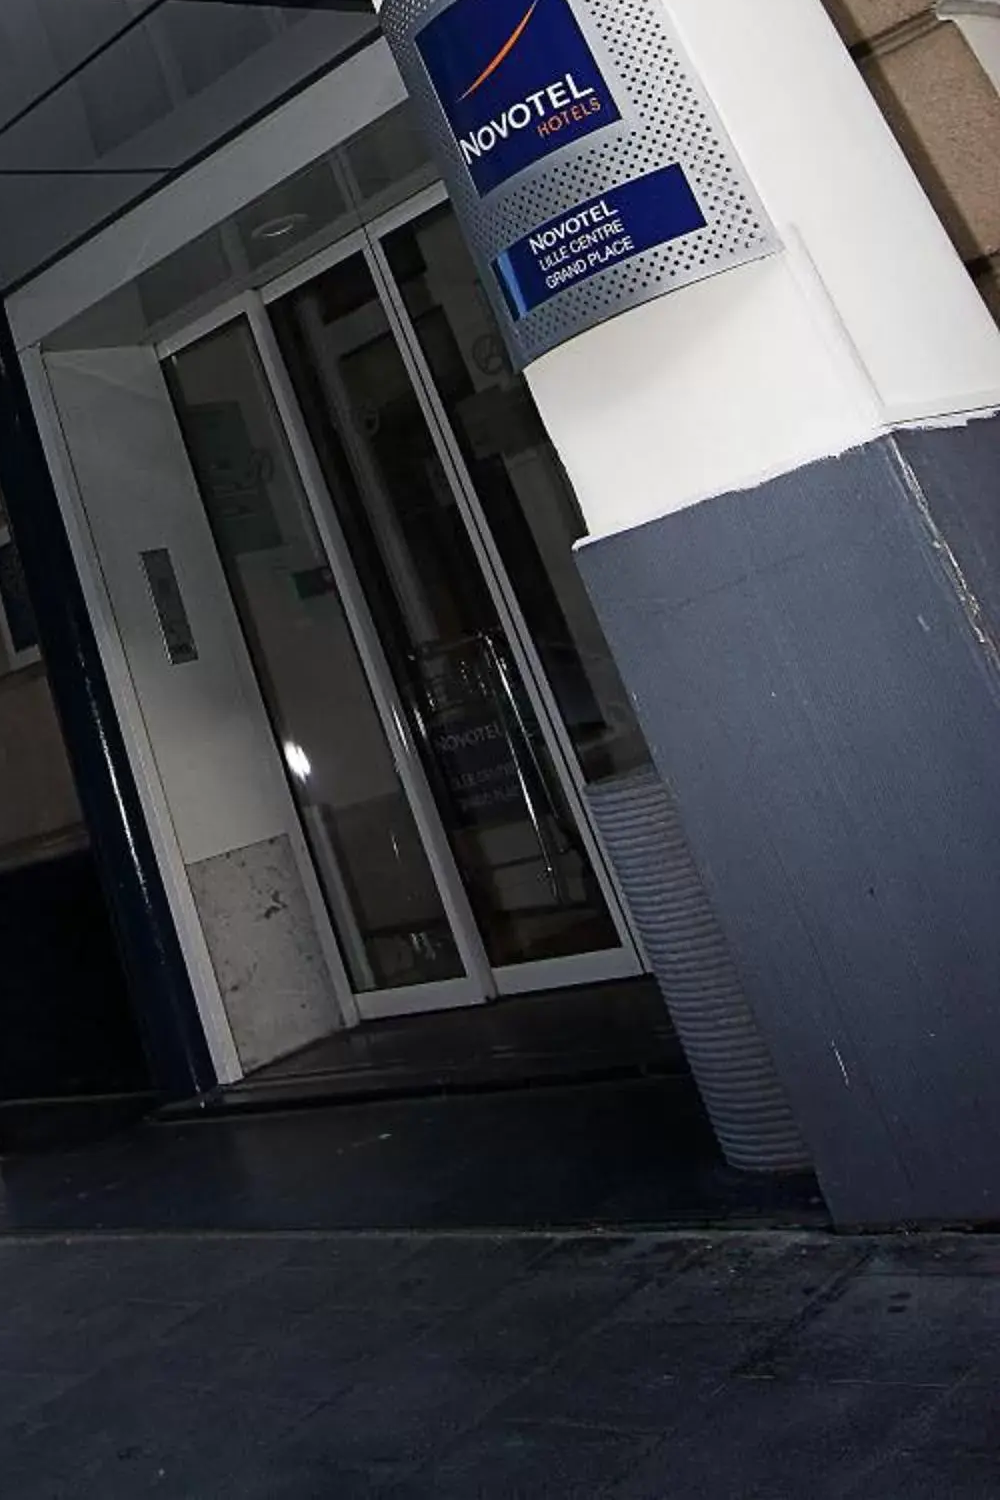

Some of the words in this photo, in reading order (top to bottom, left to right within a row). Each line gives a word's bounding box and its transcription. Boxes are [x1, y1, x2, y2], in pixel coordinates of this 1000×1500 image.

[459, 73, 595, 165] NOVOTEL
[536, 97, 601, 139] HOTELS
[528, 200, 620, 256] NOVOTEL
[538, 244, 572, 272] LILLE
[569, 218, 625, 254] CENTRE
[544, 259, 588, 290] GRAND
[588, 235, 635, 268] PLACE
